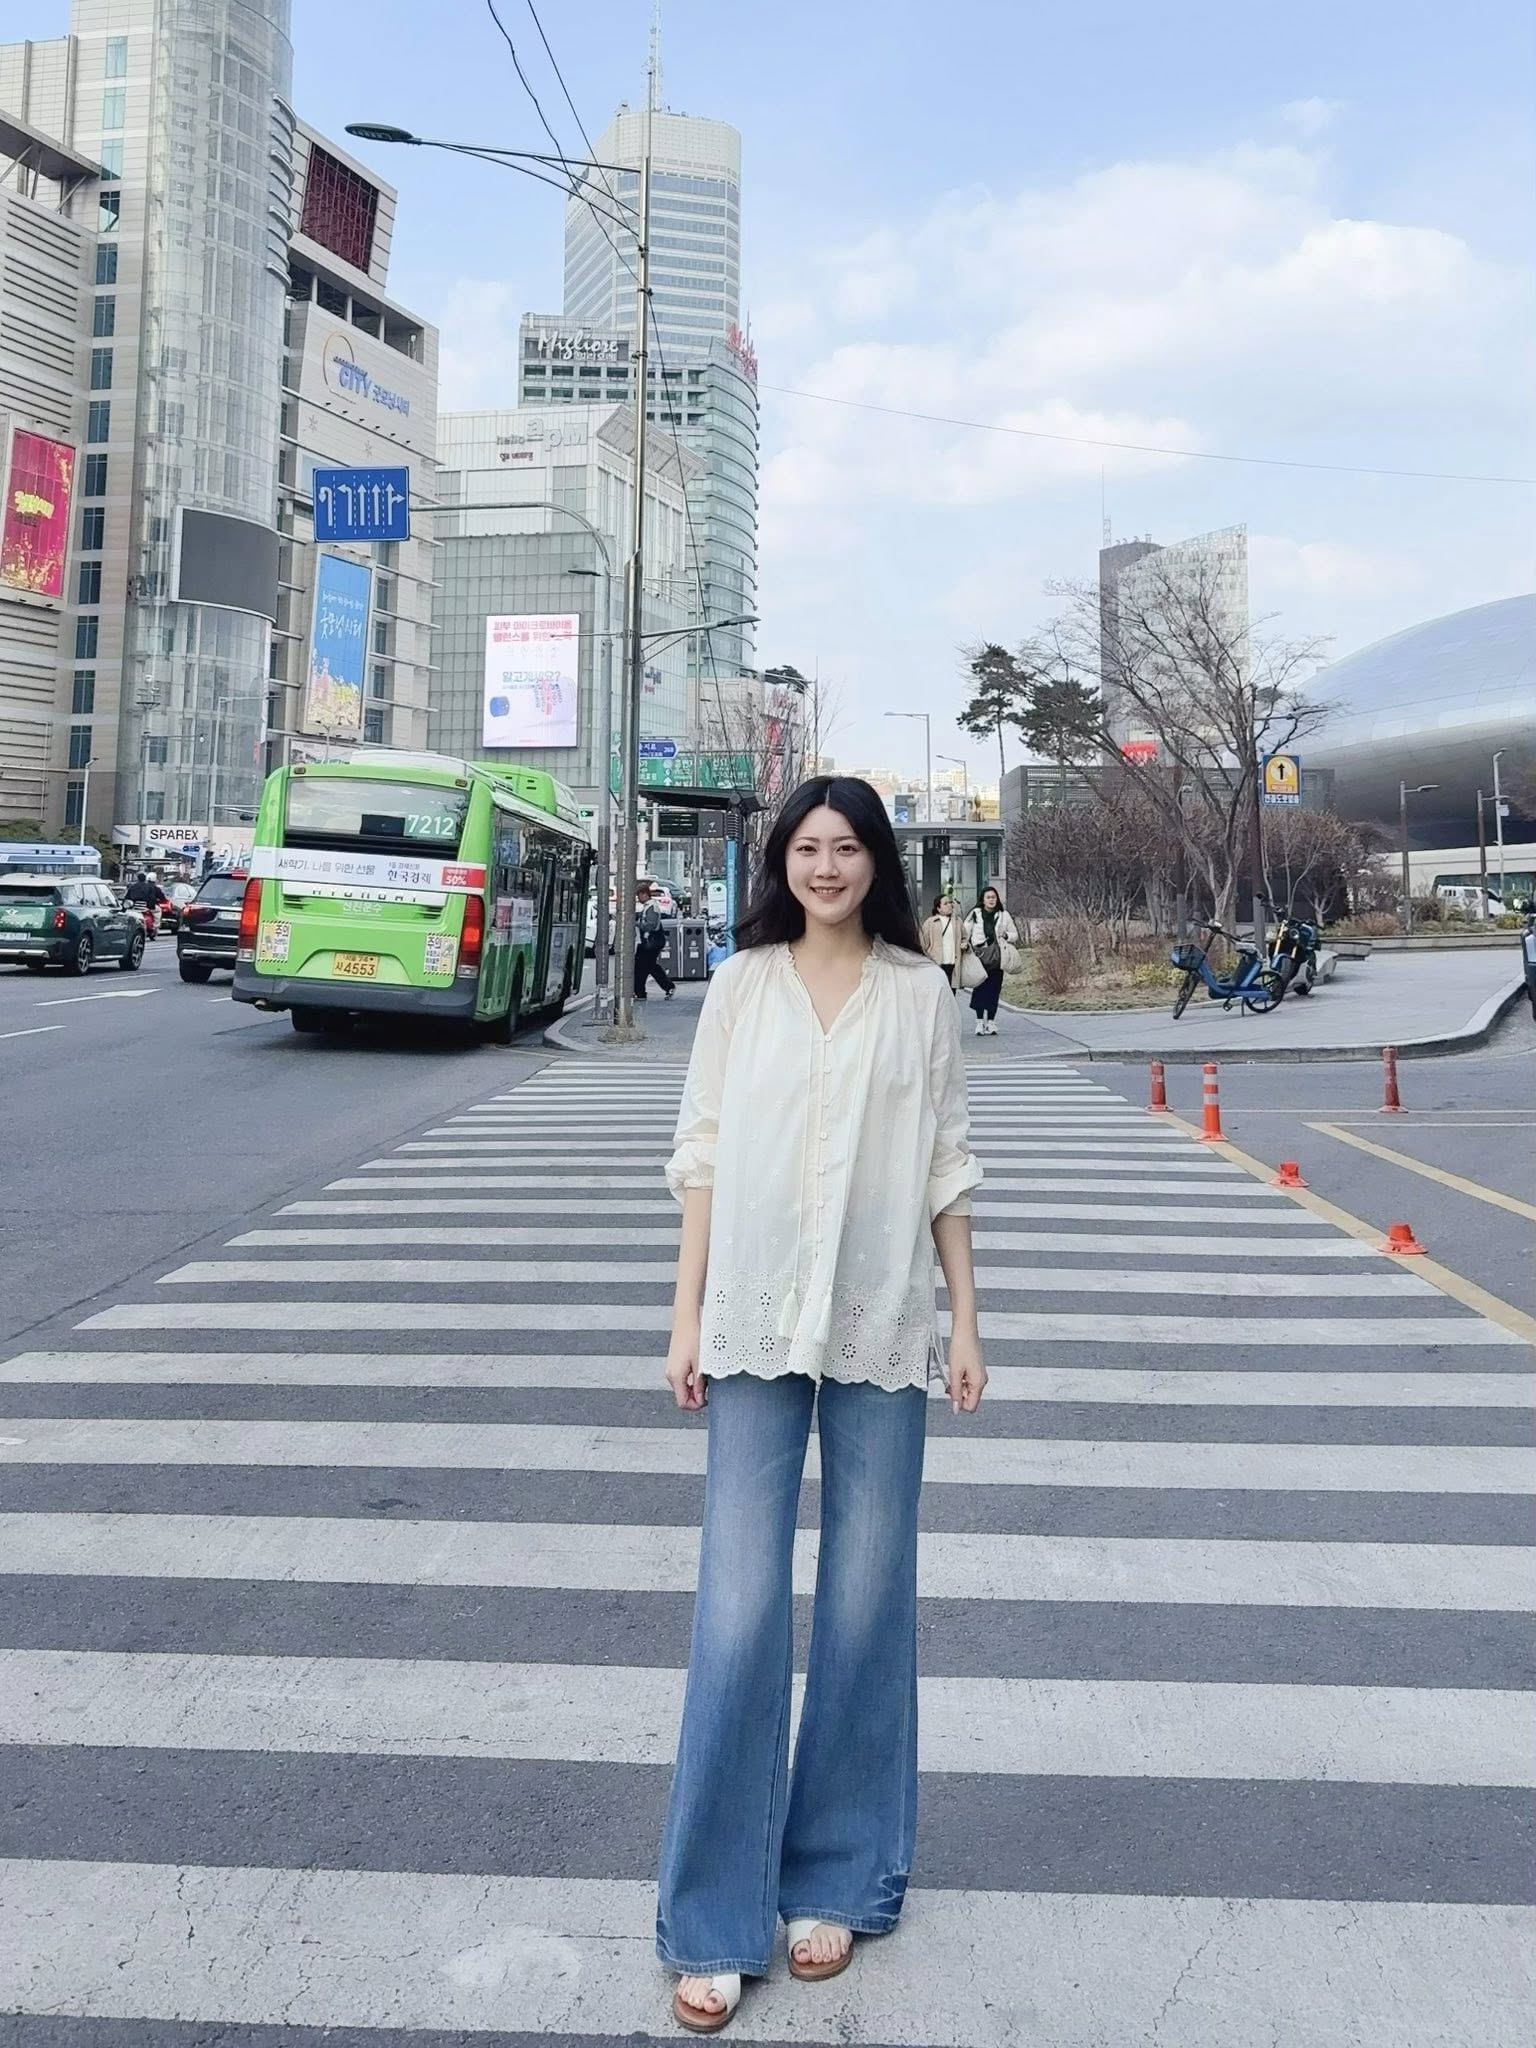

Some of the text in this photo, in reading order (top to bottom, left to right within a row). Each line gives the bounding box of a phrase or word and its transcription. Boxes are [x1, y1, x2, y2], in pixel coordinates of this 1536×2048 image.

[537, 328, 619, 360] Migliore
[339, 366, 372, 398] CITY
[408, 814, 454, 836] 7212
[150, 829, 198, 840] SPAREX
[312, 861, 332, 873] 나를
[334, 862, 354, 874] 위한
[356, 864, 376, 876] 선물
[387, 870, 432, 885] 한국경제
[446, 875, 467, 886] 50%
[344, 962, 375, 976] 4553
